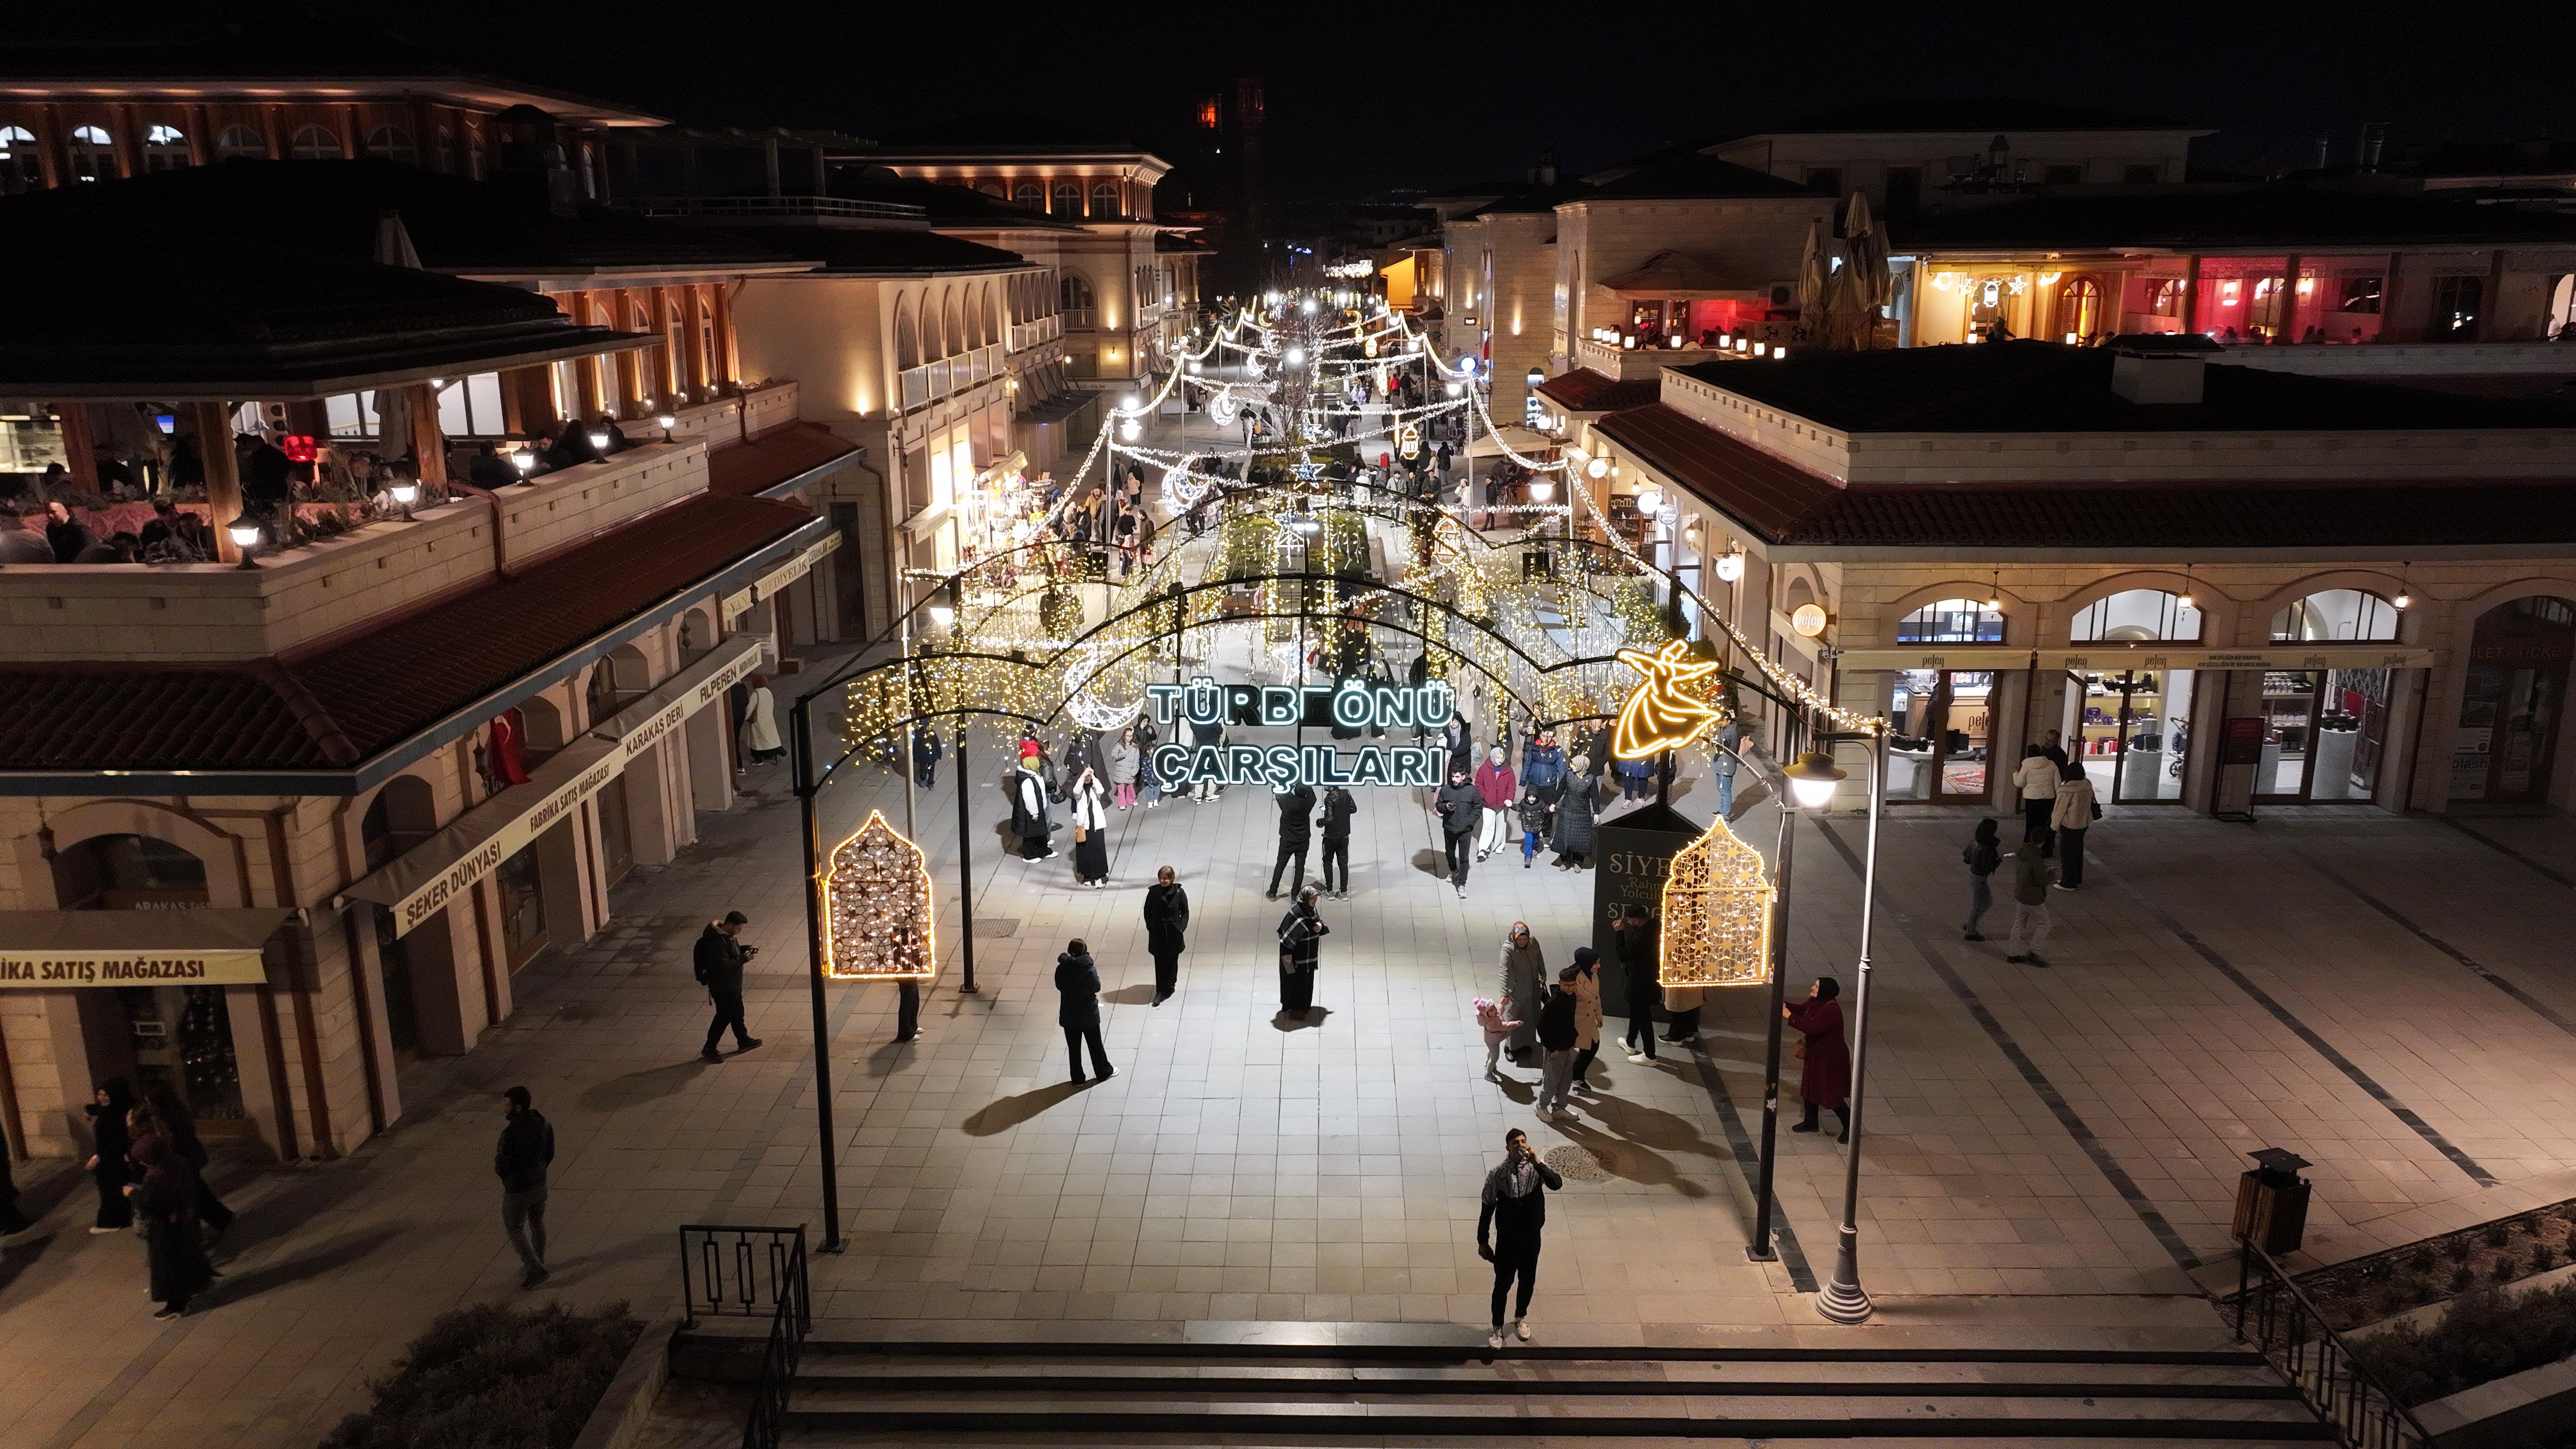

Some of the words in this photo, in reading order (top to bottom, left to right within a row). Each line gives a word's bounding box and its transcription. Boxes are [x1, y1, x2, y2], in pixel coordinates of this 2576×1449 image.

[761, 558, 808, 596] HEDİYELİK
[700, 665, 738, 703] ALPEREN
[625, 718, 665, 757] KARAKAŞ
[666, 701, 684, 728] DERİ
[1968, 712, 1989, 731] pele
[1151, 743, 1447, 794] ÇARŞILARI
[529, 799, 559, 833] FABRİKA
[560, 786, 578, 811] SATIŞ
[579, 763, 609, 797] MAĞAZASI
[1609, 851, 1671, 877] SİYE
[407, 879, 449, 928] ŞEKER
[450, 840, 501, 893] DÜNYASI
[1628, 876, 1663, 893] Rahm
[41, 960, 96, 983] SATIŞ
[102, 956, 206, 979] MAĞAZASI
